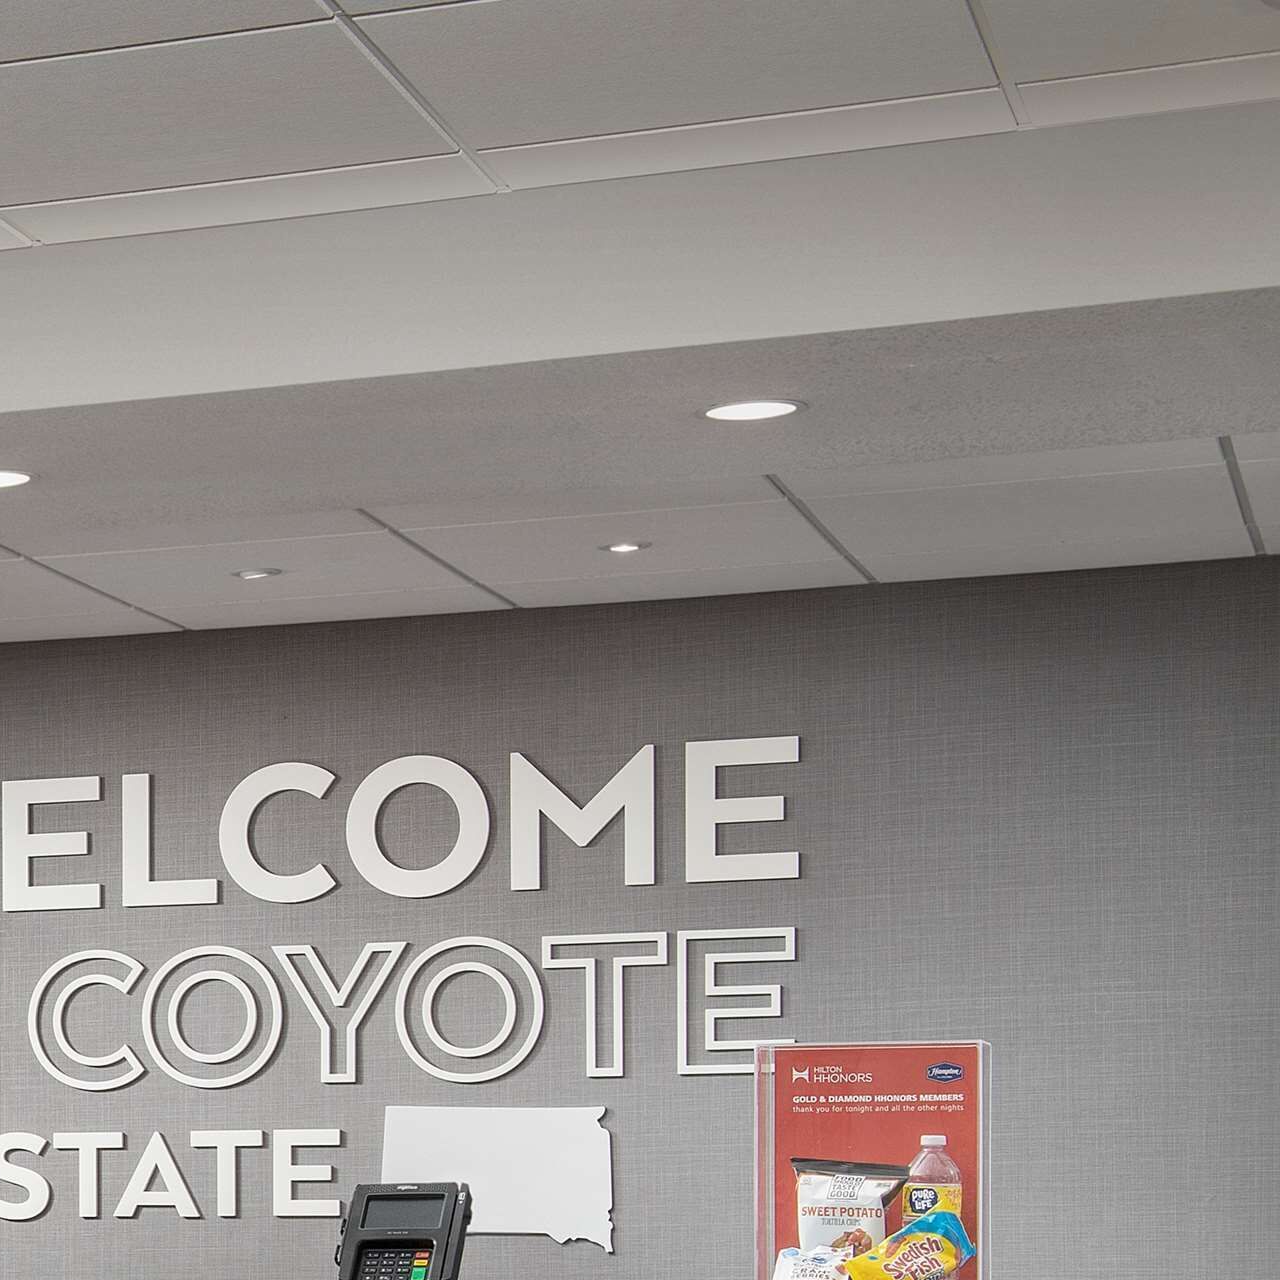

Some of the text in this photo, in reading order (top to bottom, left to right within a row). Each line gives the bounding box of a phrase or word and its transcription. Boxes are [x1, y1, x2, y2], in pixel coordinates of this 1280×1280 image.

[27, 926, 798, 1092] COYOTE
[814, 1073, 872, 1083] HHONORS
[793, 1093, 965, 1104] GOLD & DIAMOND HHONORS MEMBERS
[793, 1104, 965, 1114] thank you for tonight and all the other nights
[830, 1190, 856, 1198] GOOD
[801, 1206, 883, 1218] SWEET POTATO
[882, 1237, 945, 1280] Swedish
[905, 1256, 944, 1280] Fish
